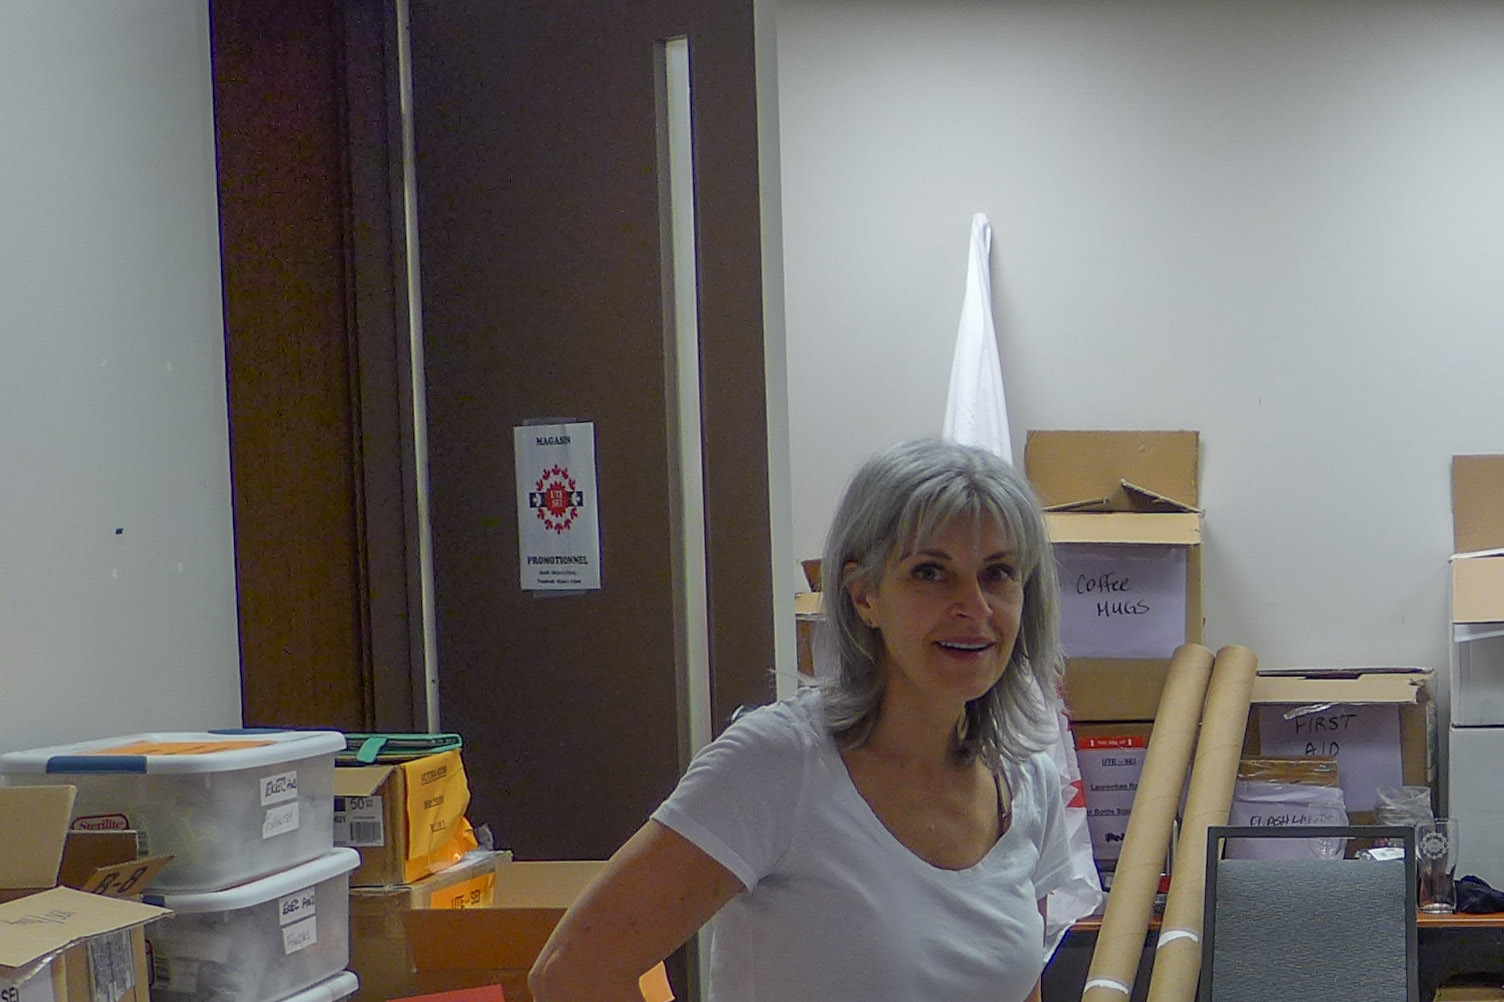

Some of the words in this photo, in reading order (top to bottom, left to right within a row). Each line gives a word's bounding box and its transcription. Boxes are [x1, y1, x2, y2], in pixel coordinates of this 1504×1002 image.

[536, 436, 571, 446] MAGASIN
[527, 556, 589, 565] PROMOTIONNEL
[1097, 600, 1150, 617] MUGS
[1294, 714, 1356, 734] FIRST
[1305, 742, 1340, 756] AID
